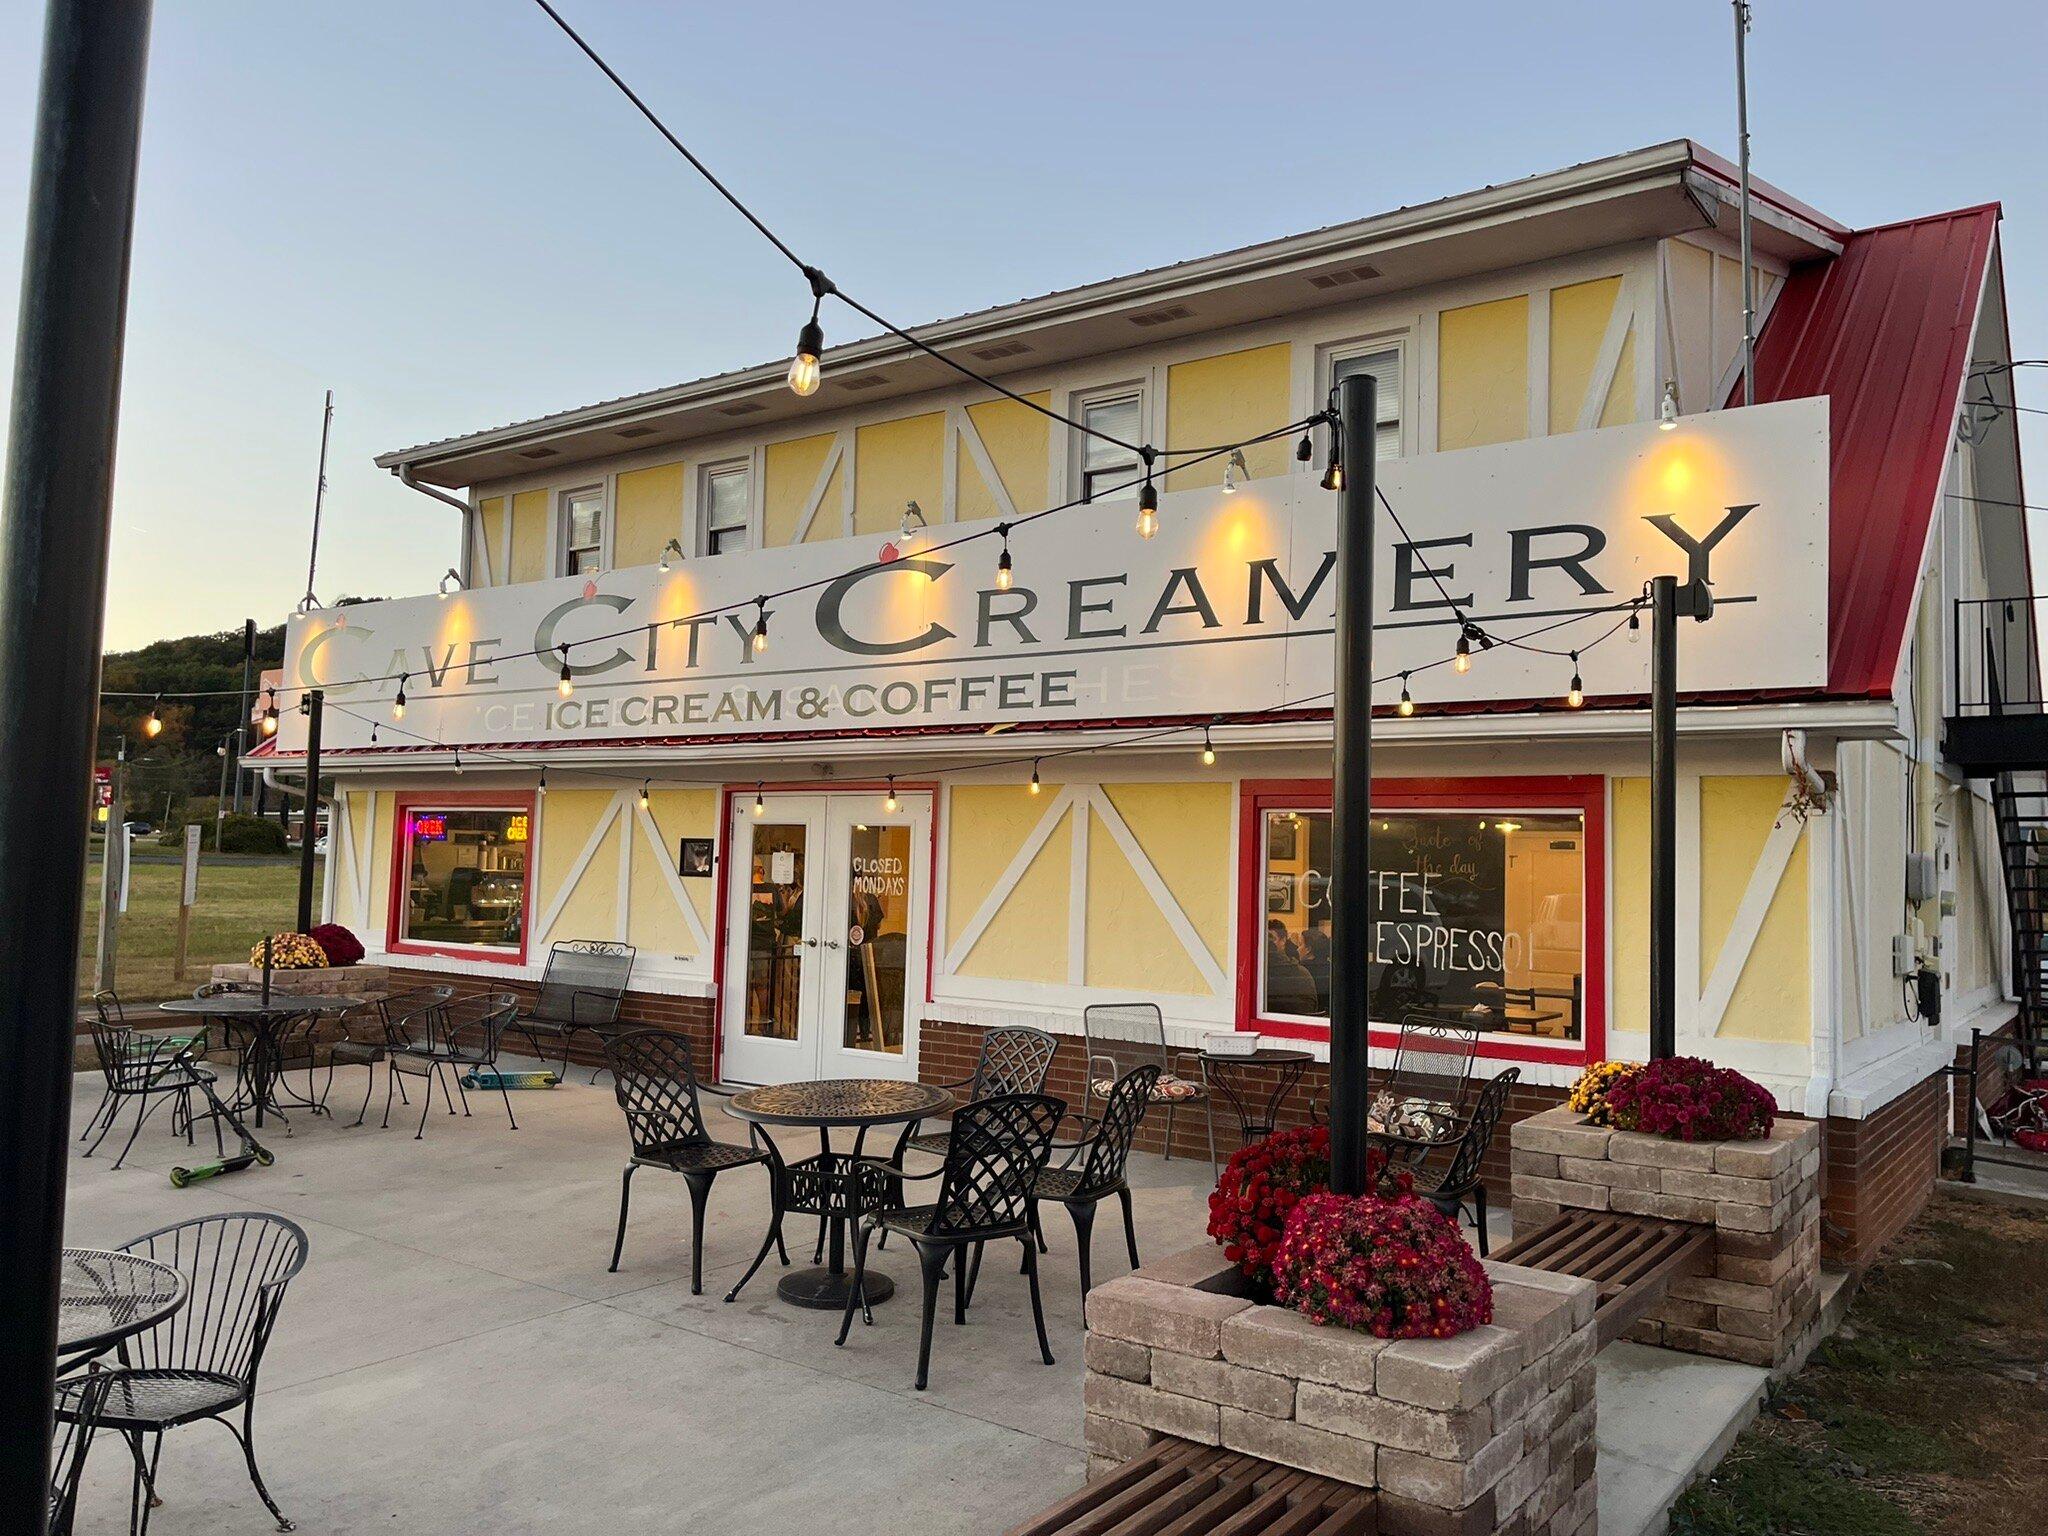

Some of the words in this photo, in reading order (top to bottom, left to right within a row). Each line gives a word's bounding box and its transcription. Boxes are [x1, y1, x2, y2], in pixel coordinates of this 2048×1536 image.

[298, 625, 502, 696] CAVE
[534, 594, 776, 677] CITY
[815, 502, 1760, 656] CREAMERY
[545, 698, 609, 731] ICE
[620, 688, 782, 726] CREAM
[796, 686, 830, 721] &
[842, 669, 1078, 718] COFFEE
[416, 820, 444, 835] OPEN
[853, 856, 903, 875] CLOSED
[1449, 853, 1481, 881] day
[853, 875, 905, 896] MONDAYS
[1299, 869, 1443, 916] CFEE
